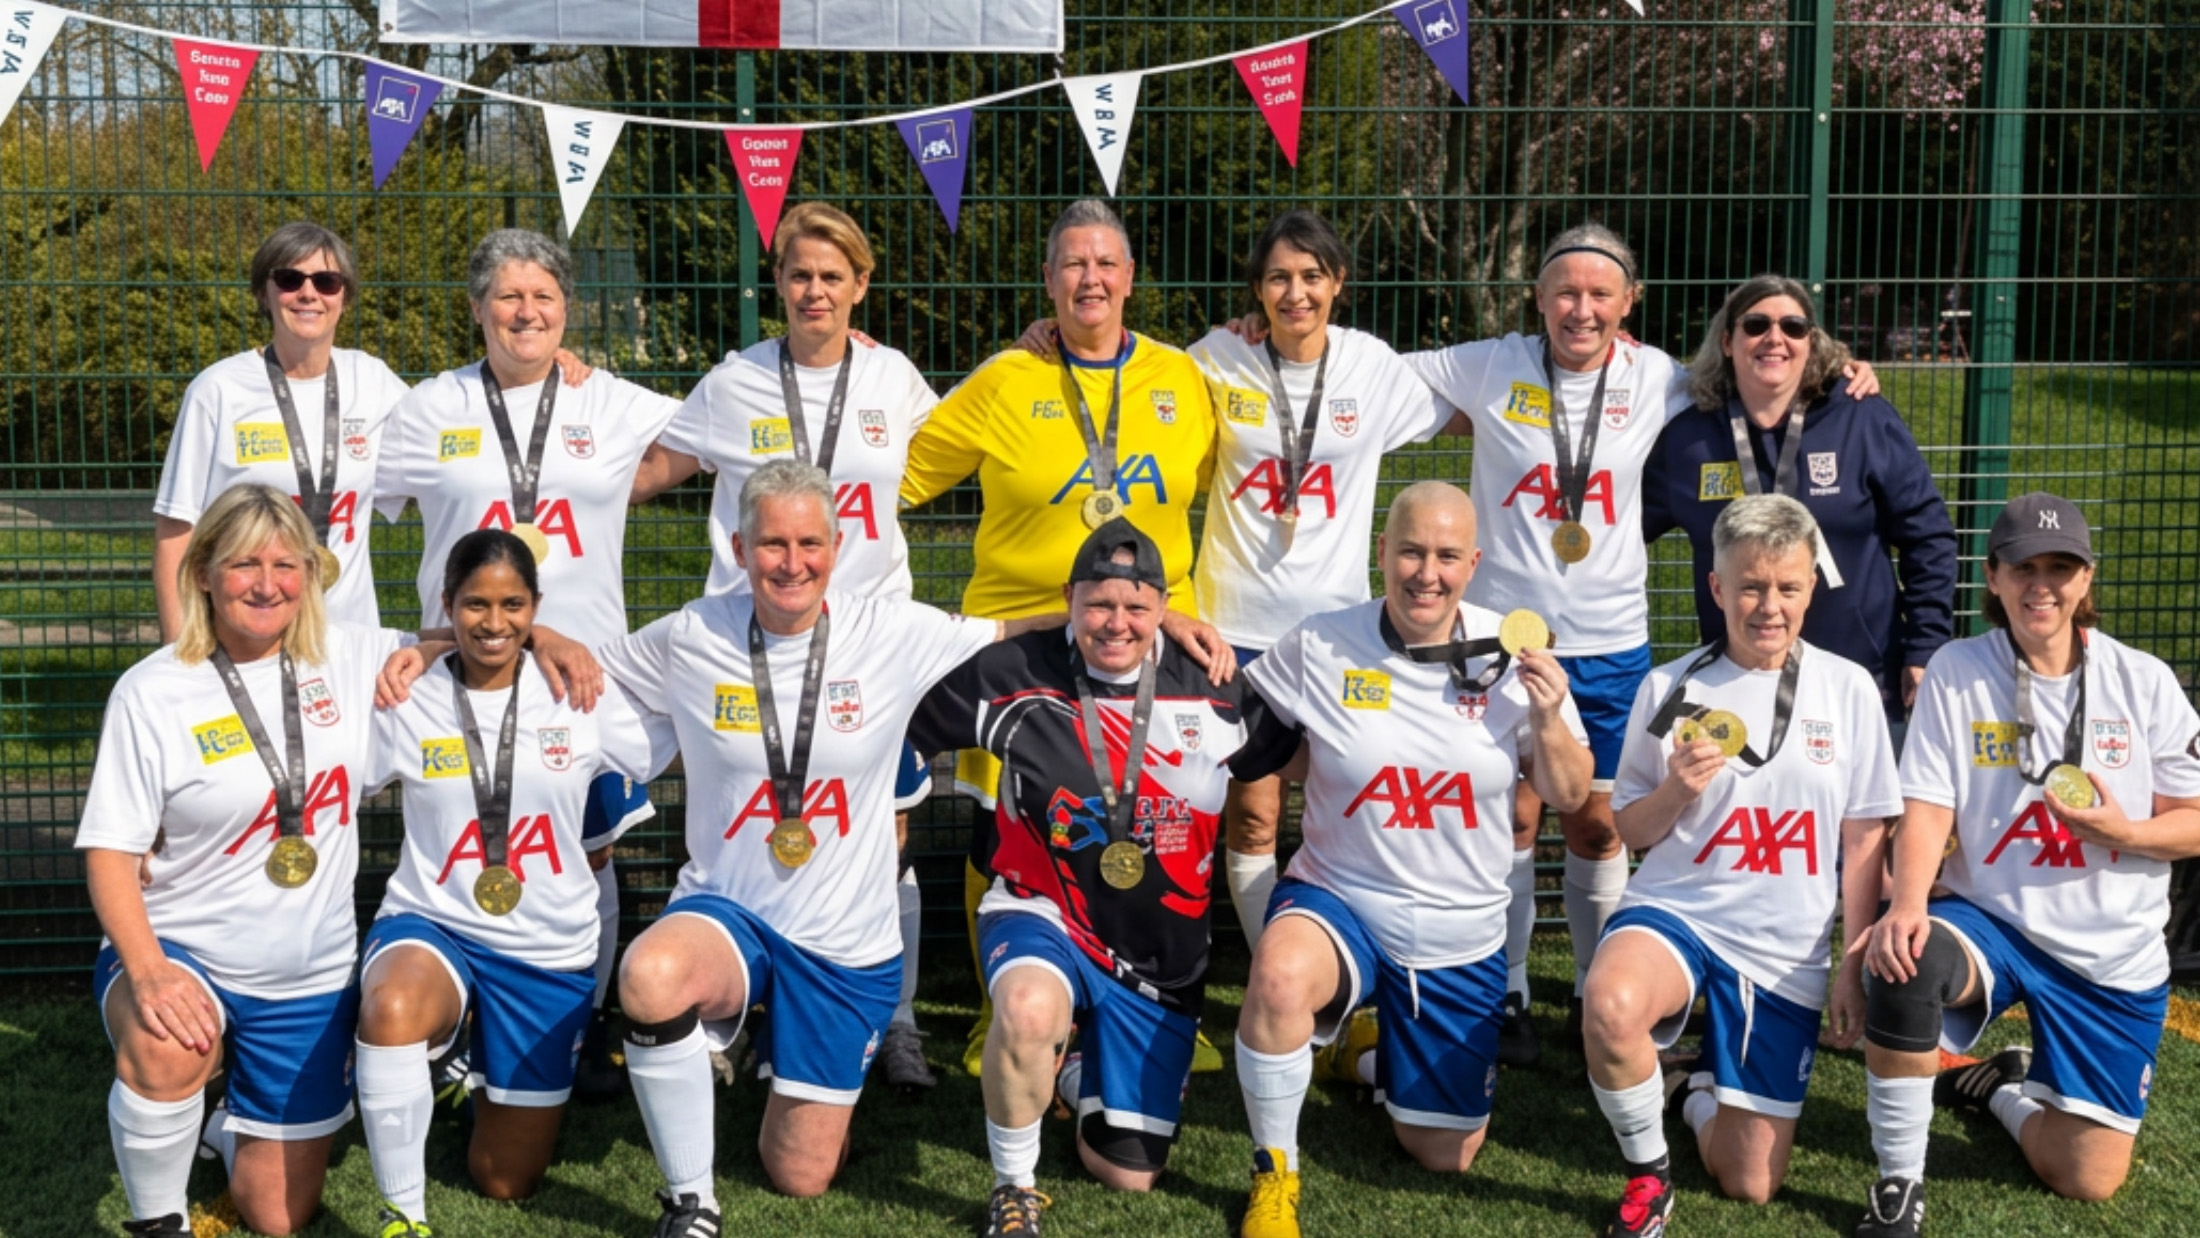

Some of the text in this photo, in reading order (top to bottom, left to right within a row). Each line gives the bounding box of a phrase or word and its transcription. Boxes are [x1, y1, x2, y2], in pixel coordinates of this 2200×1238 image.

[477, 498, 584, 557] AA
[1343, 766, 1479, 829] AXA
[1693, 807, 1818, 876] AXA
[1983, 800, 2119, 867] AX
